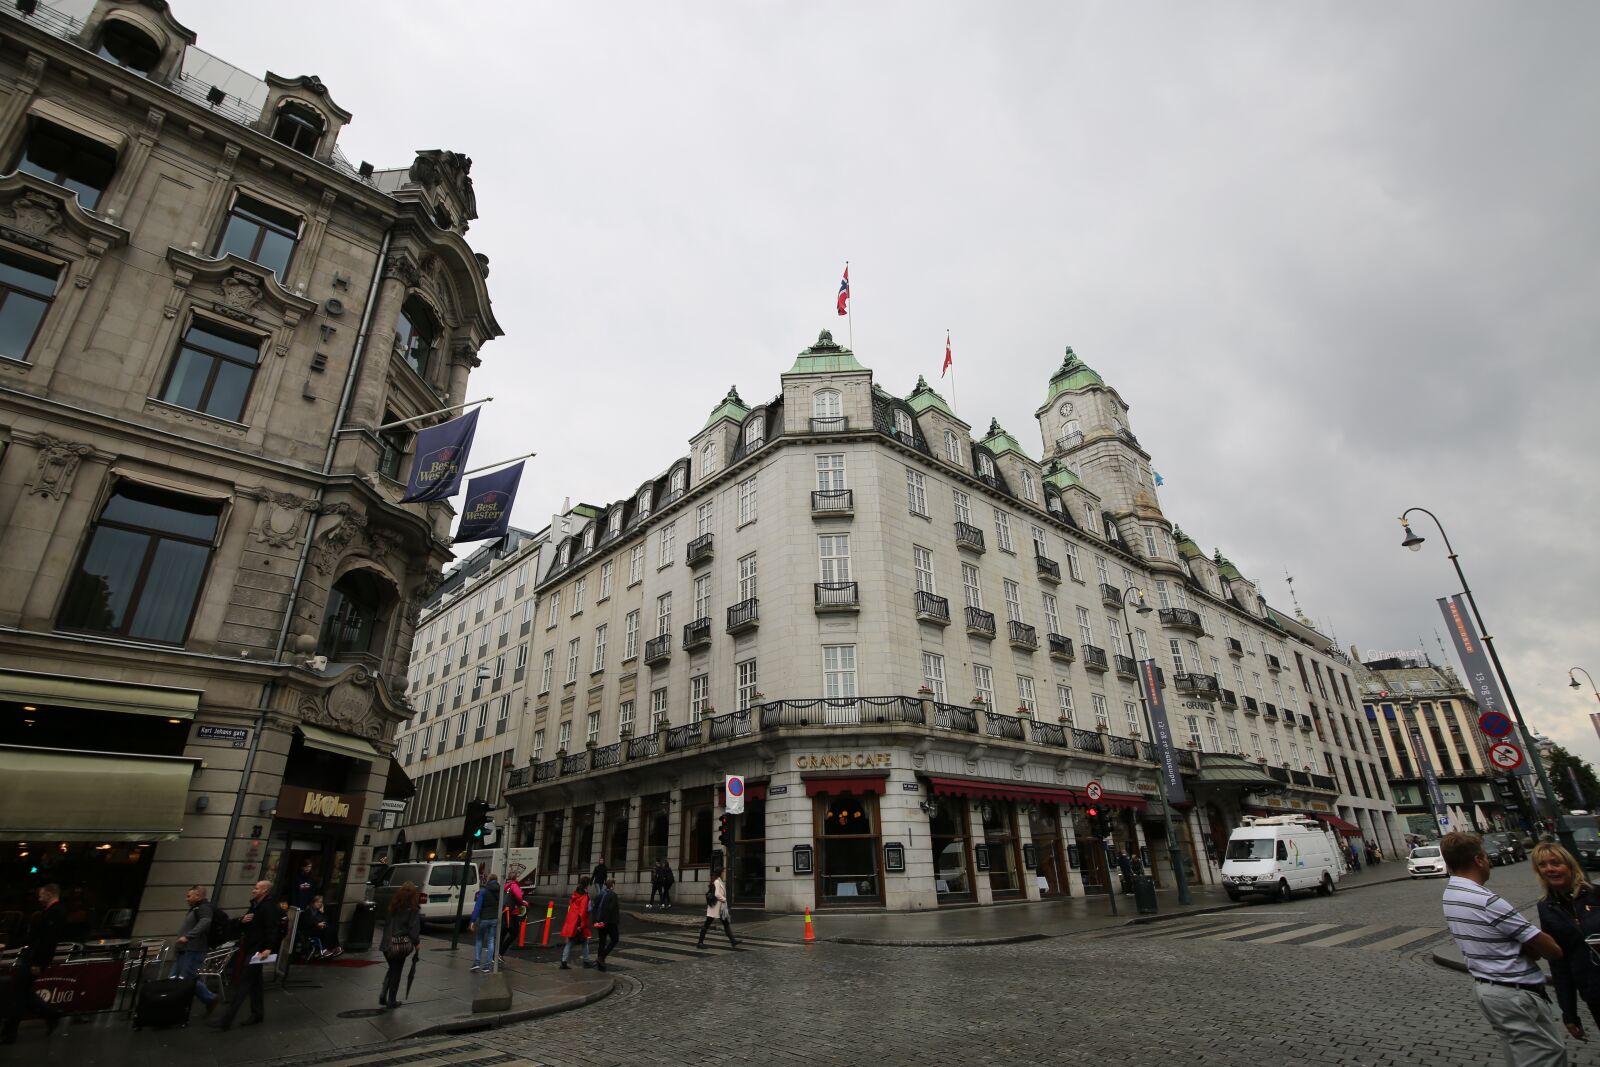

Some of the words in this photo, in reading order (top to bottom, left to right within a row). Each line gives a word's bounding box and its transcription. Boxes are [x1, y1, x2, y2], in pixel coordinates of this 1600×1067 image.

[303, 271, 351, 401] HOTEL
[431, 461, 450, 473] Bes
[475, 502, 498, 513] Best
[1475, 672, 1484, 685] 13.
[1481, 685, 1491, 696] og
[1485, 696, 1495, 709] 14.
[233, 730, 246, 738] gate
[796, 754, 852, 769] GRAND
[51, 987, 74, 1004] Luca
